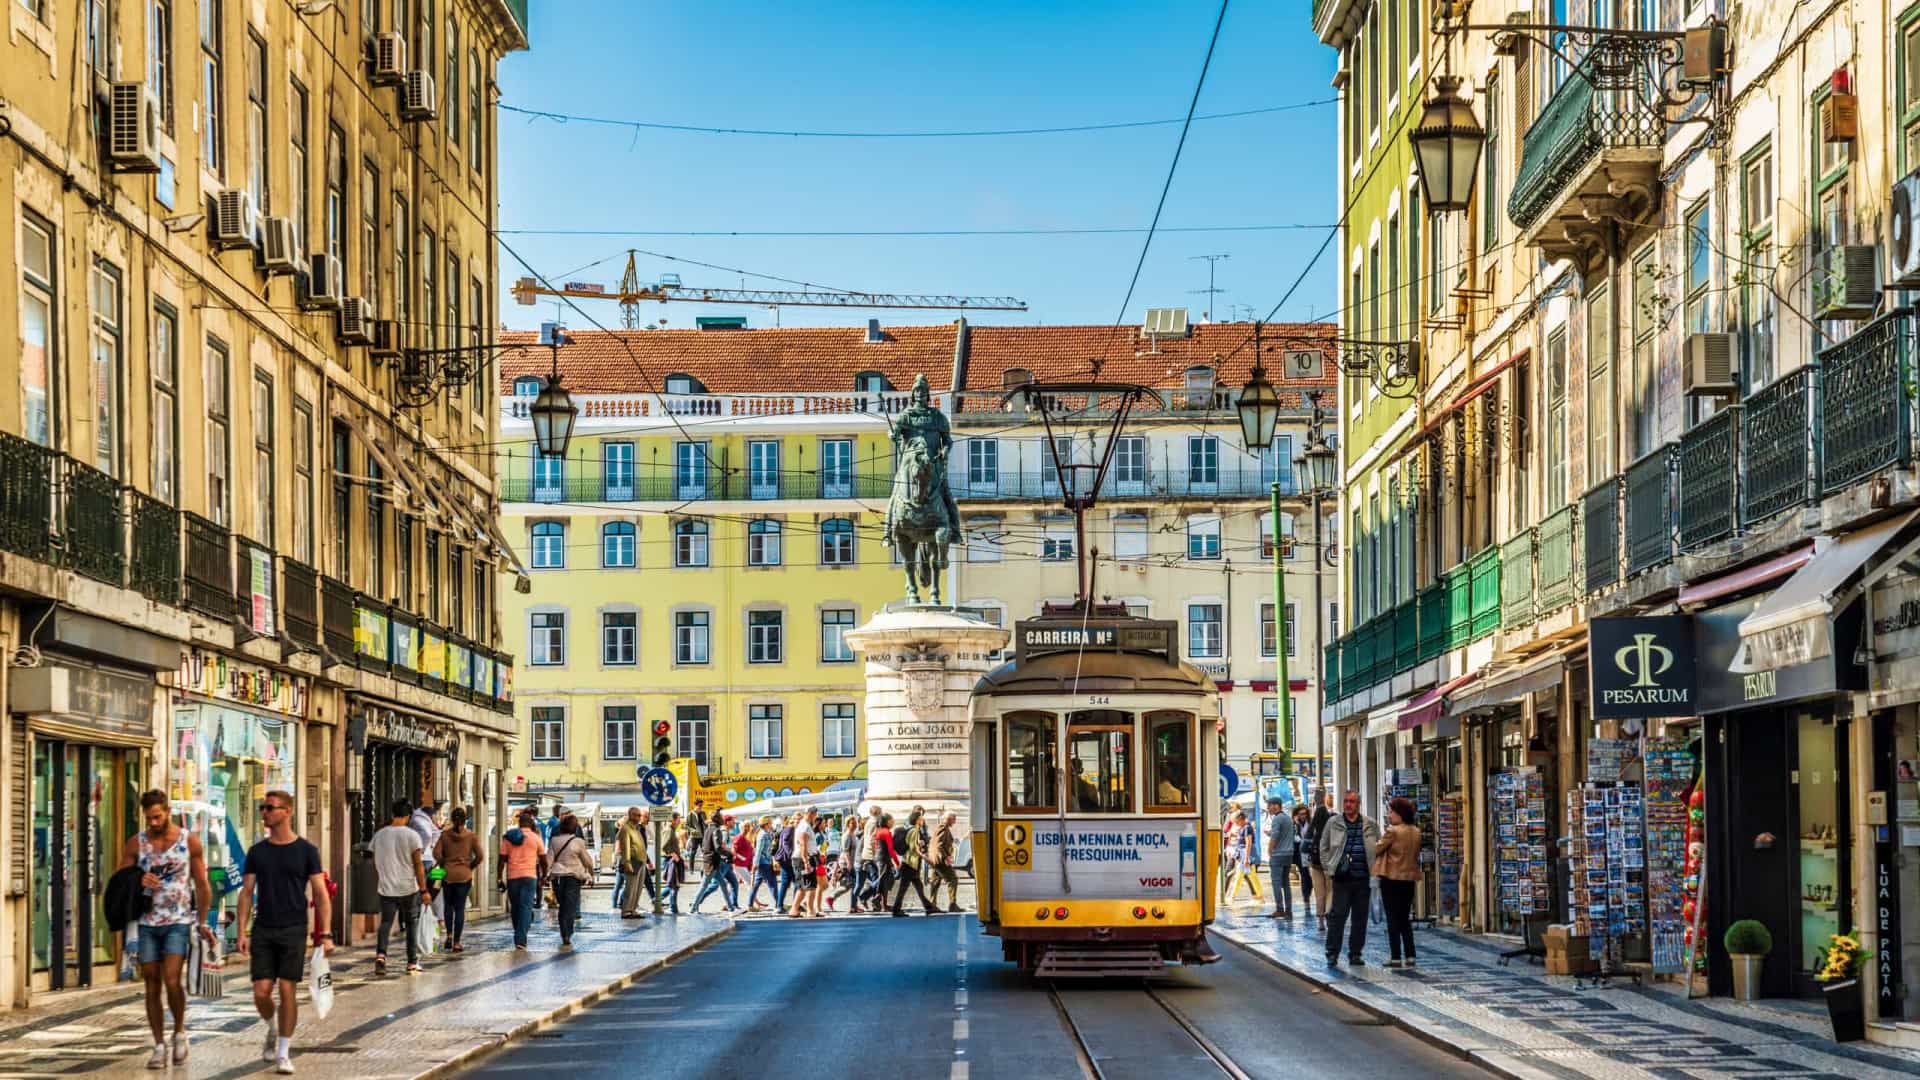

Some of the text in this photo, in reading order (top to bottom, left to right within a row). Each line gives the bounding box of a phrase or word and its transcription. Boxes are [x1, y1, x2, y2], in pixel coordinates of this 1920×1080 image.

[1293, 353, 1312, 369] 10
[1026, 631, 1089, 645] CARREIRA
[1089, 696, 1110, 705] 544
[1603, 688, 1688, 704] PESARUM
[897, 725, 920, 736] DOM
[1078, 833, 1123, 846] MENINA
[1126, 833, 1132, 846] E
[1136, 833, 1169, 848] MOÇA,
[1064, 849, 1142, 861] FRESQUINHA.
[1139, 877, 1173, 887] VIGOR
[1880, 864, 1891, 996] LUA DE PRATA
